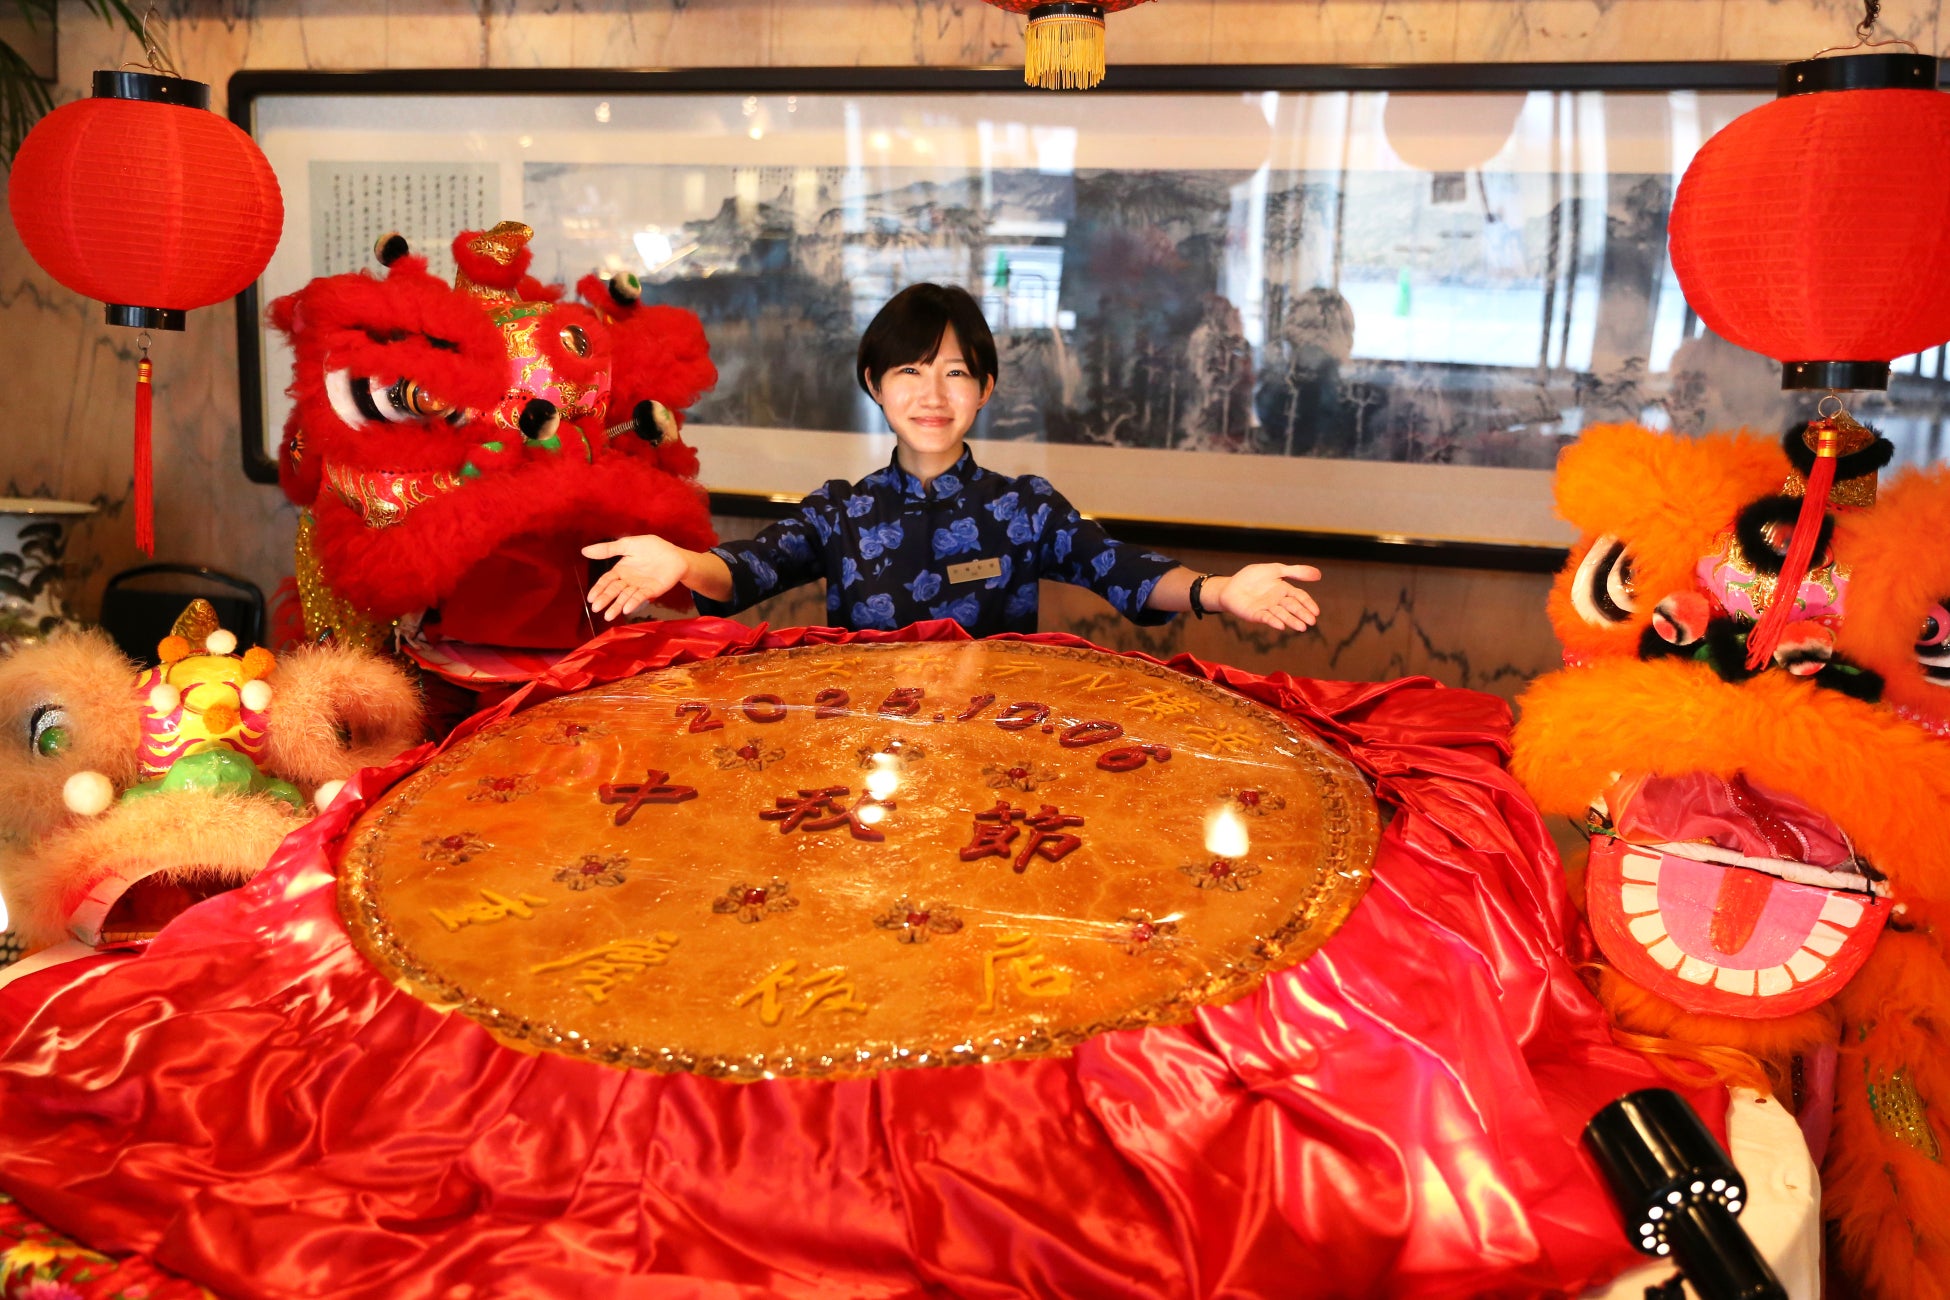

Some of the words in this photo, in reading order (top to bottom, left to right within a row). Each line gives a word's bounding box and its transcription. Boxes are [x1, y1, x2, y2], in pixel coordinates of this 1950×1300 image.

[674, 687, 1172, 773] 2025.10.06
[598, 768, 1085, 873] 中秋節
[429, 888, 1074, 1027] 重慶飯店
